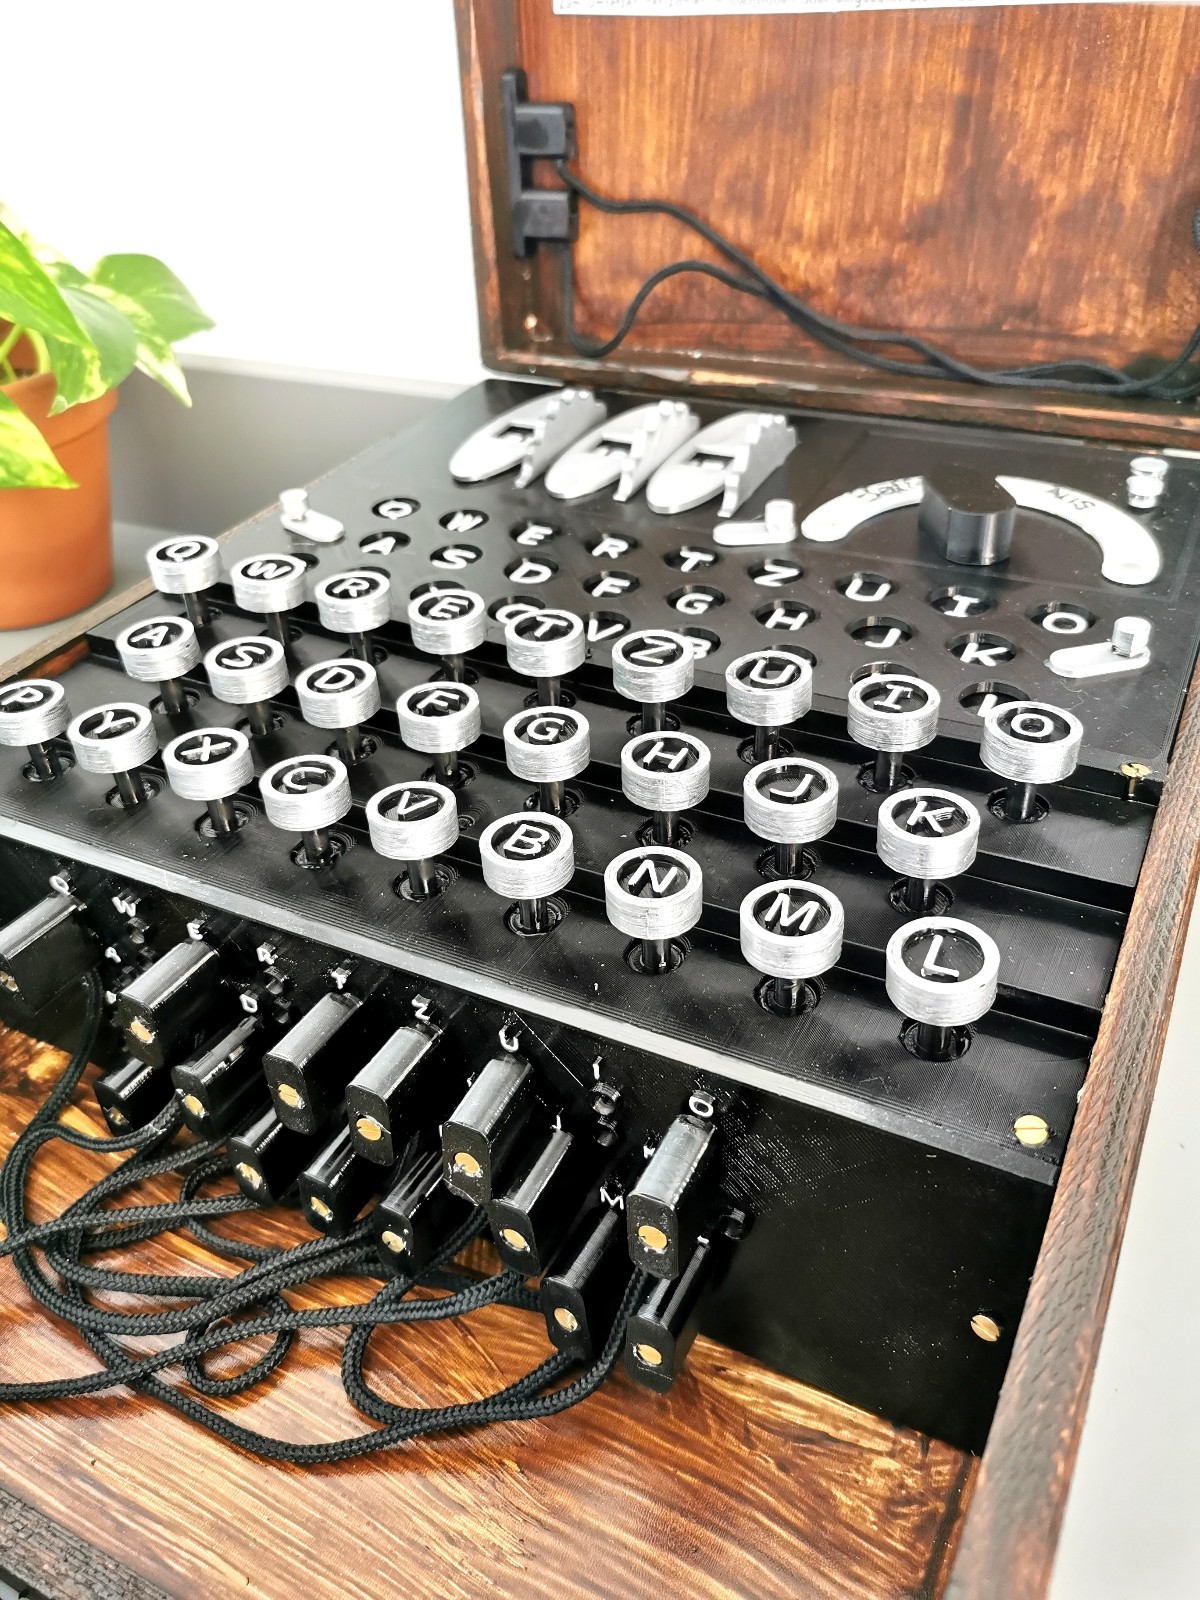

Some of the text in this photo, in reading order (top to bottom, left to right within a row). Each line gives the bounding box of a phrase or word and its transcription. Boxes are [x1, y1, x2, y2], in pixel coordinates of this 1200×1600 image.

[361, 536, 1010, 667] A S D F G H J K
[377, 500, 1089, 634] Q W E R T Z U I O
[587, 619, 624, 643] V
[247, 561, 291, 580] W
[334, 578, 370, 598] R
[429, 596, 470, 619] E
[535, 614, 573, 639] T
[631, 637, 678, 665] Z
[750, 658, 797, 686] U
[873, 683, 914, 711] I
[1010, 713, 1055, 738] O
[130, 626, 956, 834] A S D F G H J K
[2, 687, 960, 978] P Y X C V B N M L
[600, 1186, 624, 1211] M
